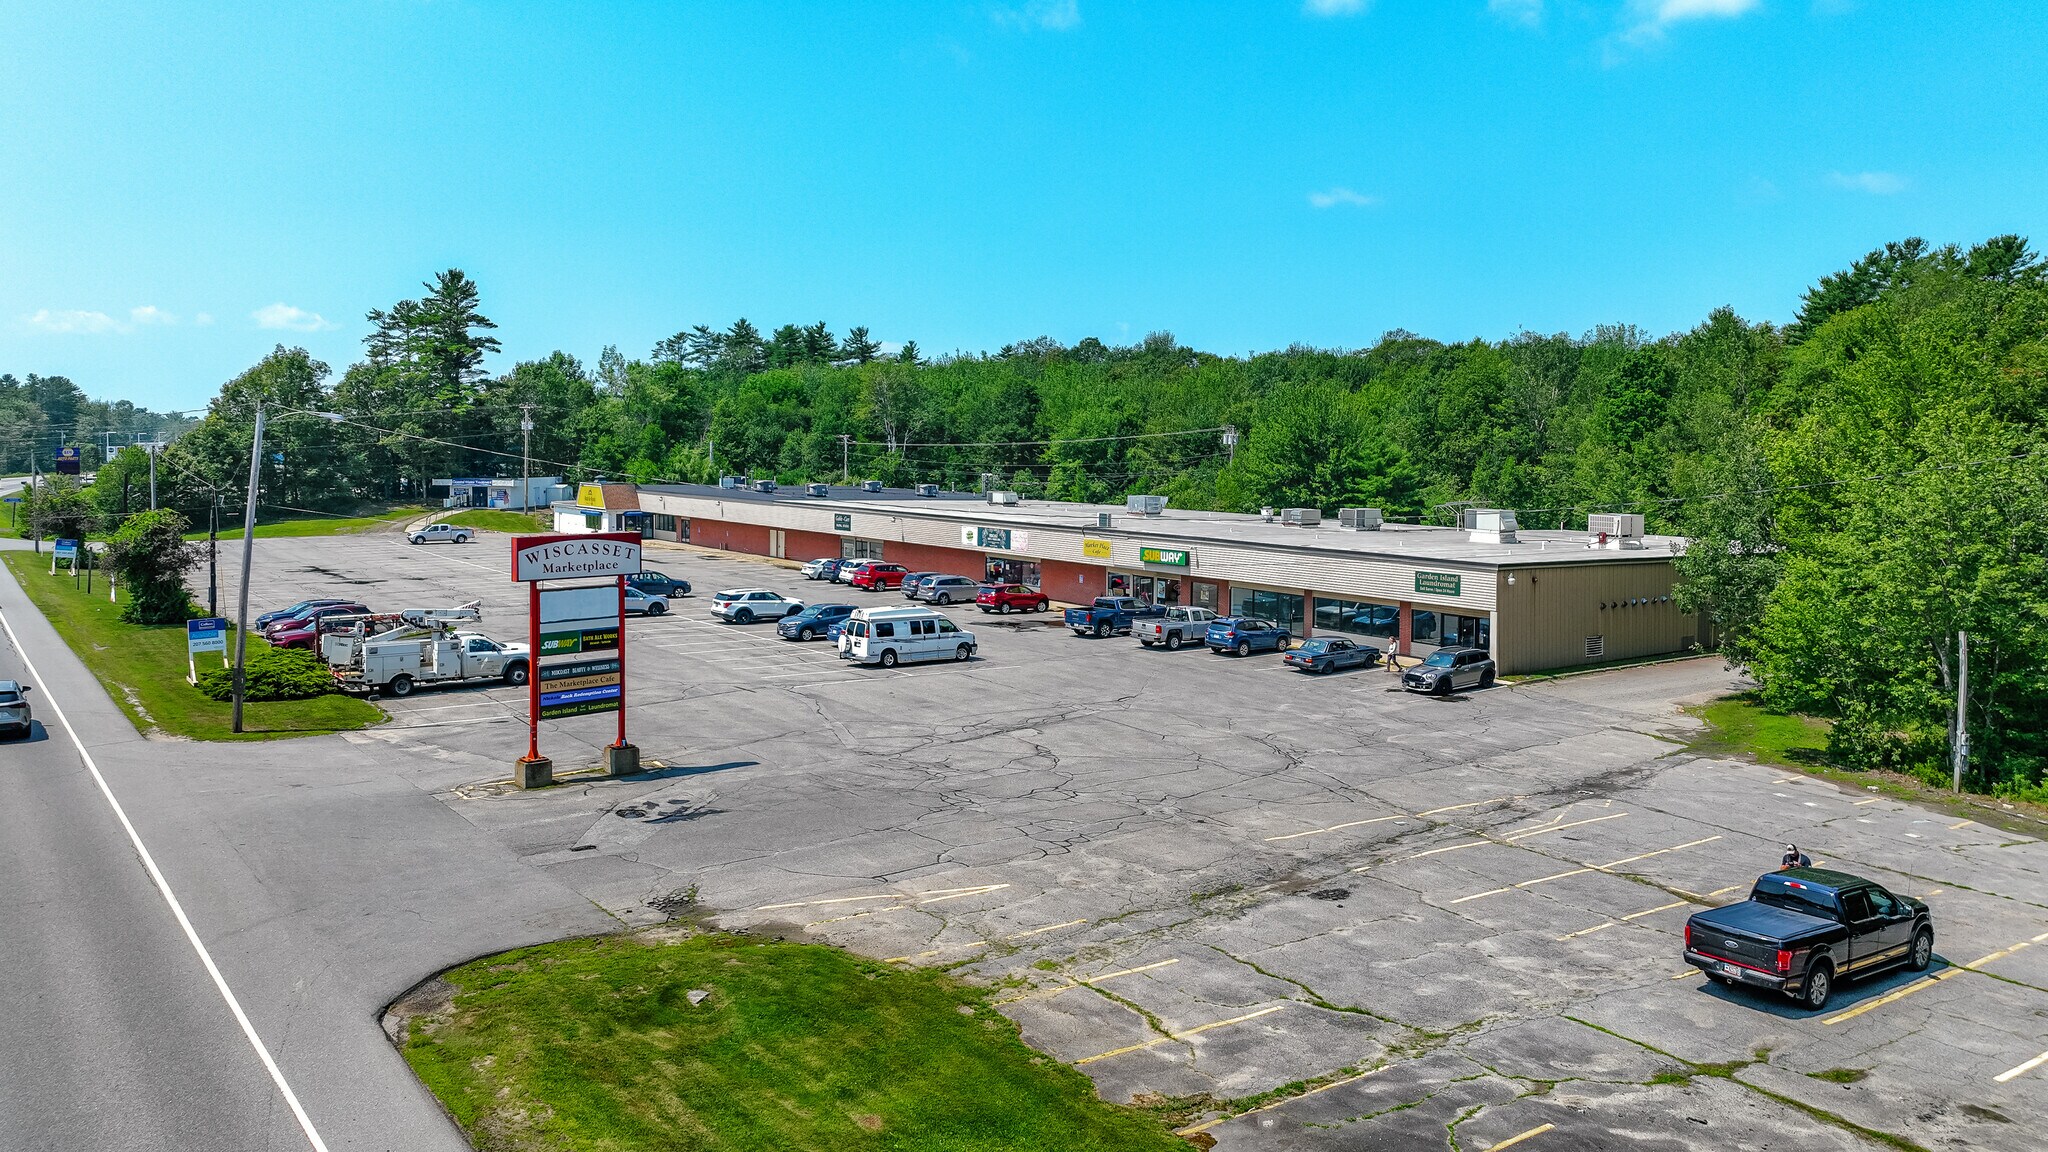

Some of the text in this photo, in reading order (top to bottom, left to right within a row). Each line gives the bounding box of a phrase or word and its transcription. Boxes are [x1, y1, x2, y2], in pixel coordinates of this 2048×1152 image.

[525, 543, 636, 565] WISCASSET
[1143, 549, 1183, 563] SUBWAY
[543, 560, 619, 573] Marketplace
[1420, 579, 1456, 588] Laundromat
[541, 638, 578, 649] SUBWAY
[560, 678, 599, 688] Marketplace
[574, 690, 602, 698] Redemption
[541, 709, 562, 717] Garden
[562, 706, 578, 714] Island
[588, 701, 619, 710] Laundromat
